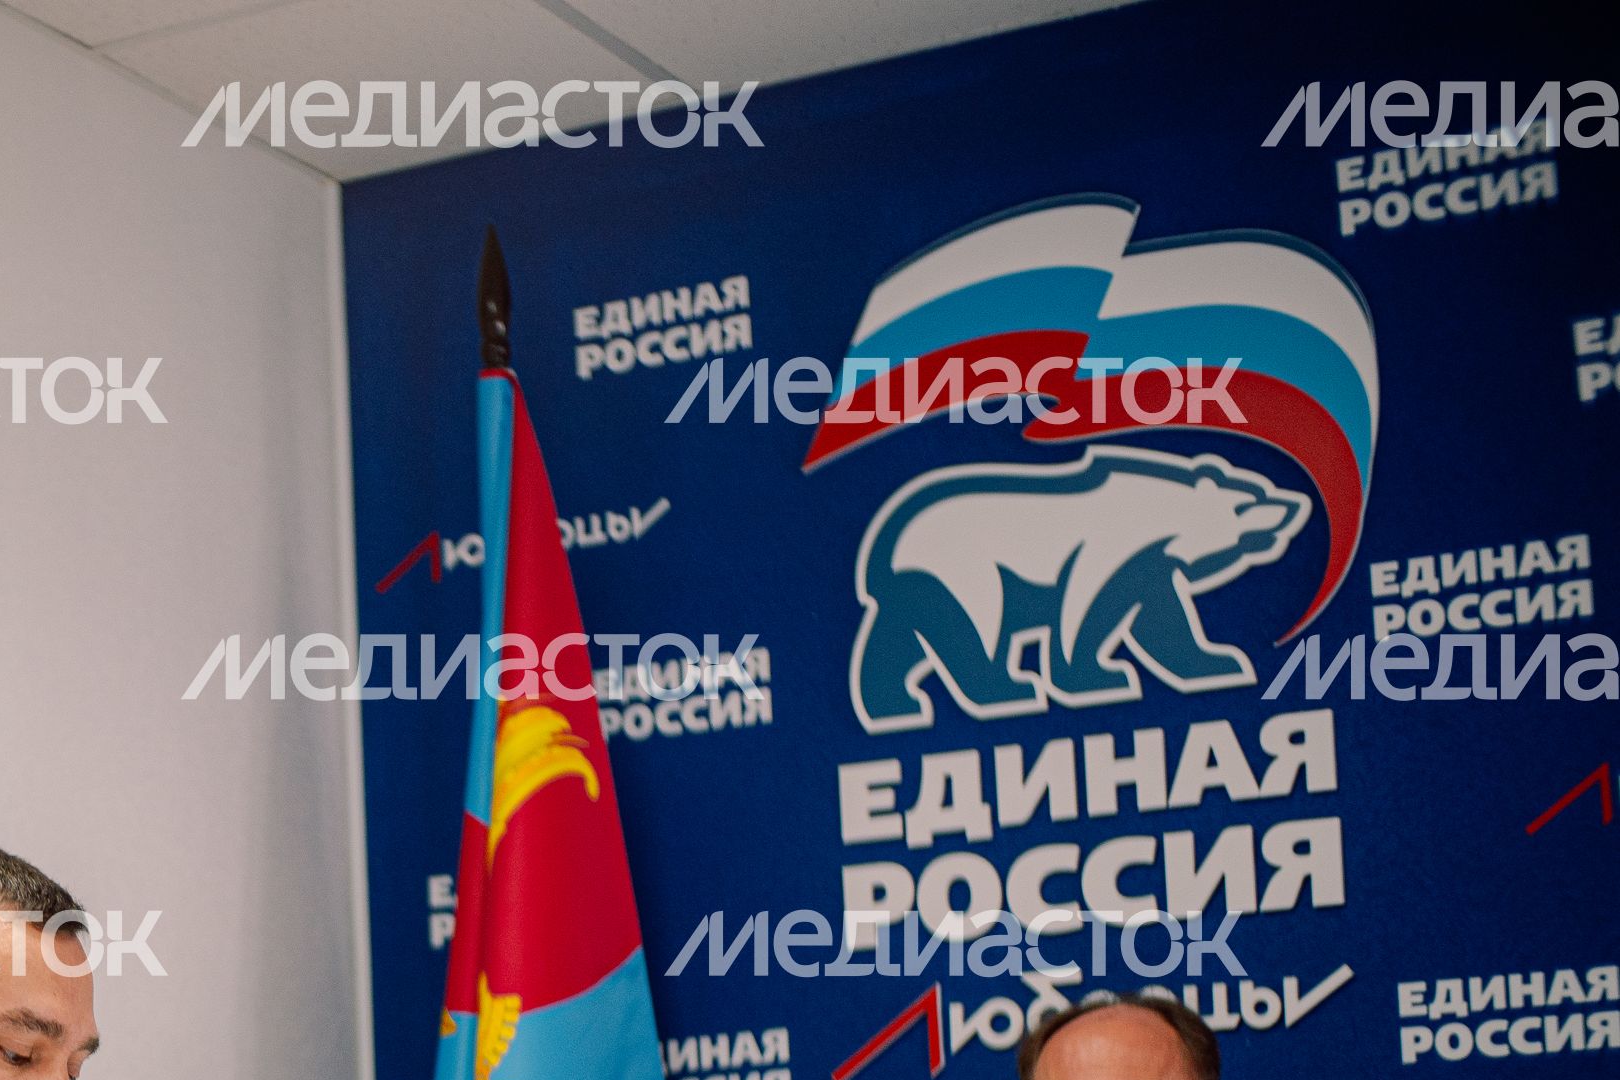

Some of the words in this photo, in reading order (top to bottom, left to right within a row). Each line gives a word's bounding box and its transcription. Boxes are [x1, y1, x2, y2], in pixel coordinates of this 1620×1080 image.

[1336, 116, 1553, 193] ЕДИНАЯ
[1339, 161, 1557, 236] РОССИЯ
[573, 275, 750, 339] ЕДИНАЯ
[576, 313, 753, 380] РОССИЯ
[1370, 534, 1591, 598] ЕДИНАЯ
[1373, 579, 1594, 642] РОССИЯ
[598, 687, 773, 743] РОССИЯ
[838, 708, 1337, 849] ЕДИНАЯ
[842, 816, 1345, 952] РОССИЯ
[1398, 965, 1620, 1020] ЕДИНАЯ
[661, 1026, 790, 1074] ИНАЯ
[1400, 1010, 1620, 1065] РОССИЯ
